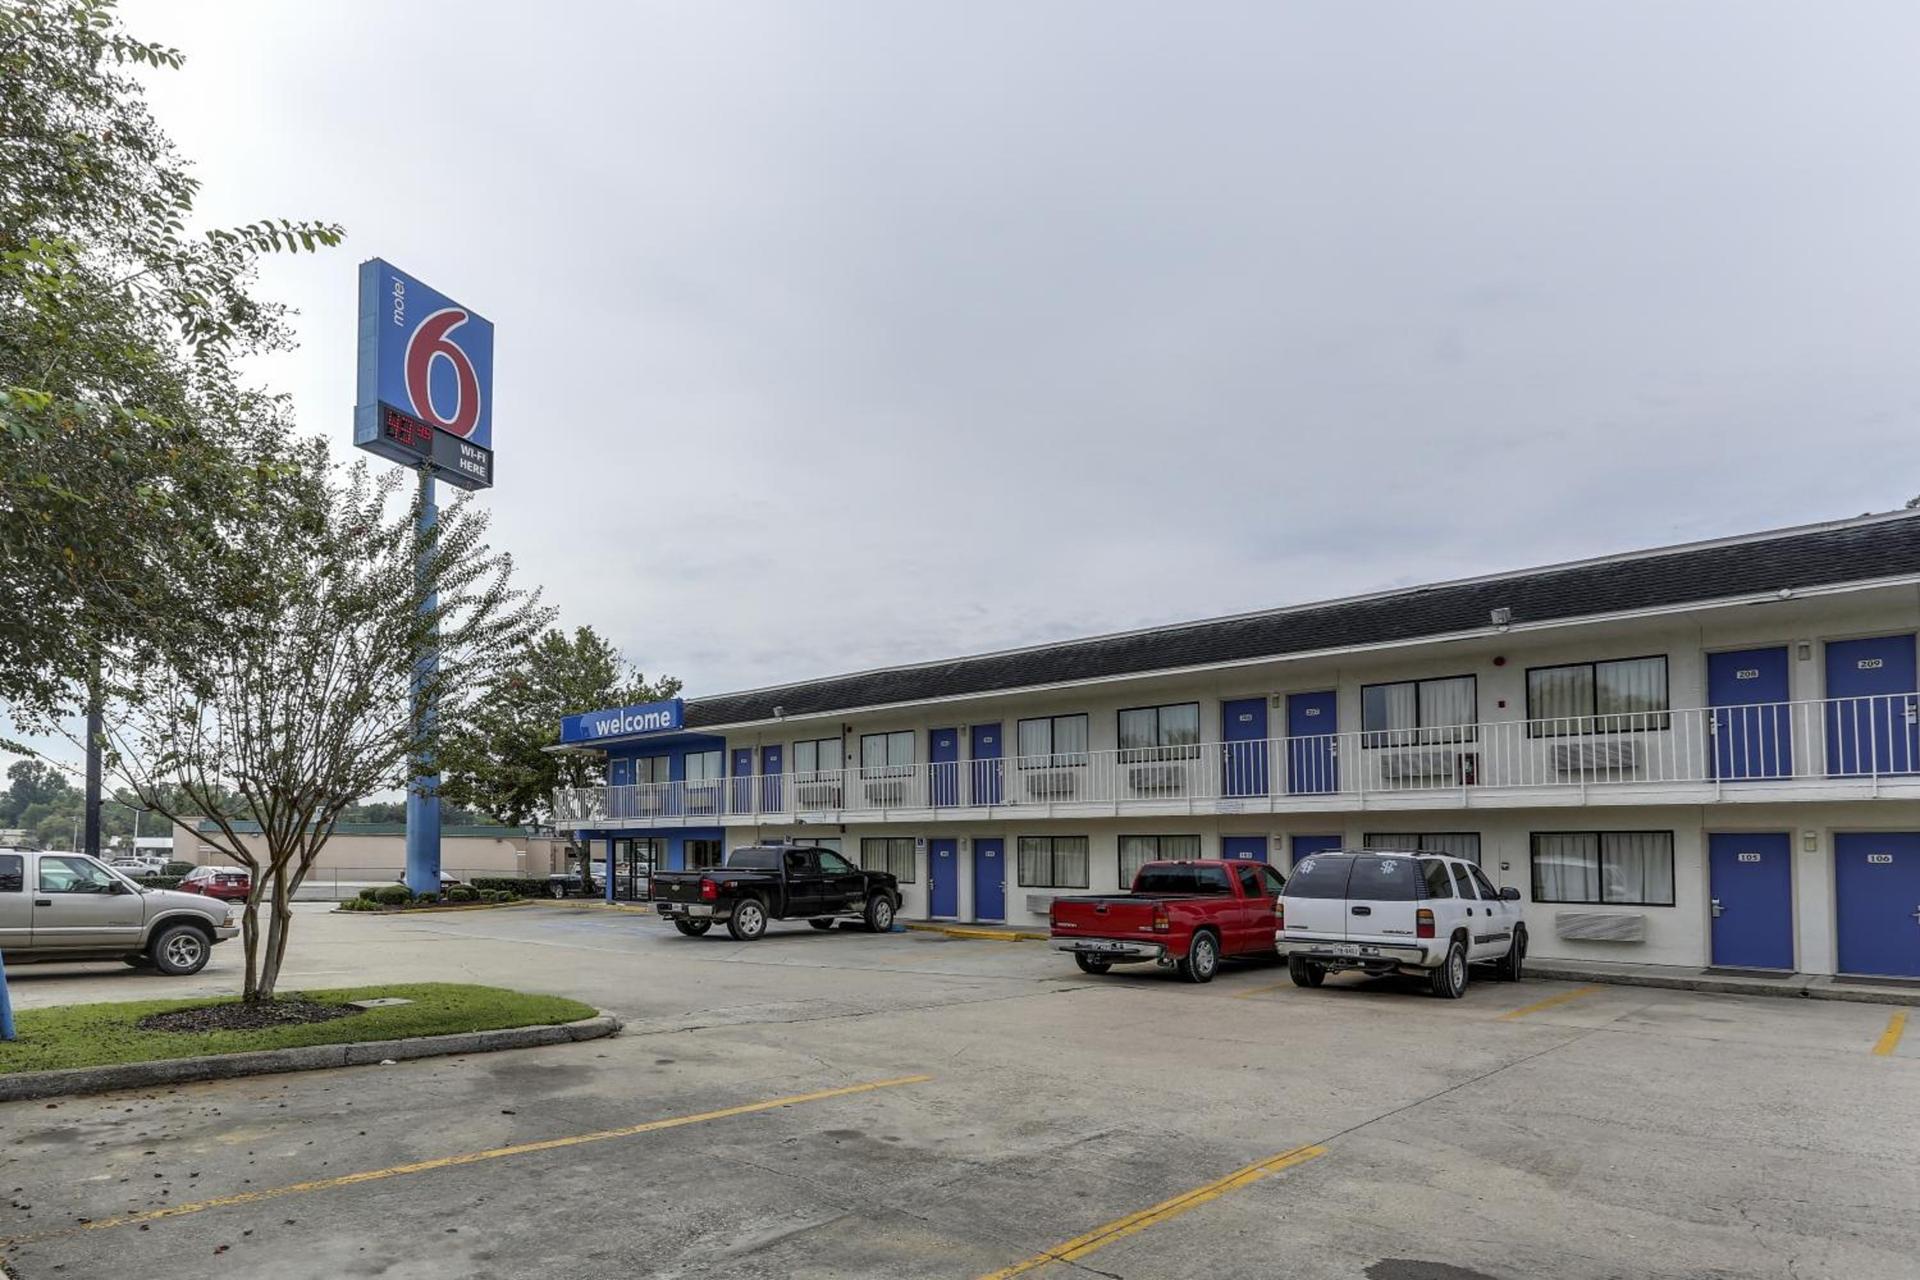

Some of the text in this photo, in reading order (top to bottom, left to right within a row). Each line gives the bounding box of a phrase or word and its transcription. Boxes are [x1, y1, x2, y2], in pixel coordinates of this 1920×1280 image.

[391, 276, 405, 327] motel
[404, 307, 480, 439] 6
[460, 443, 487, 463] WI-FI
[460, 457, 487, 477] HERE
[595, 709, 671, 736] welcome
